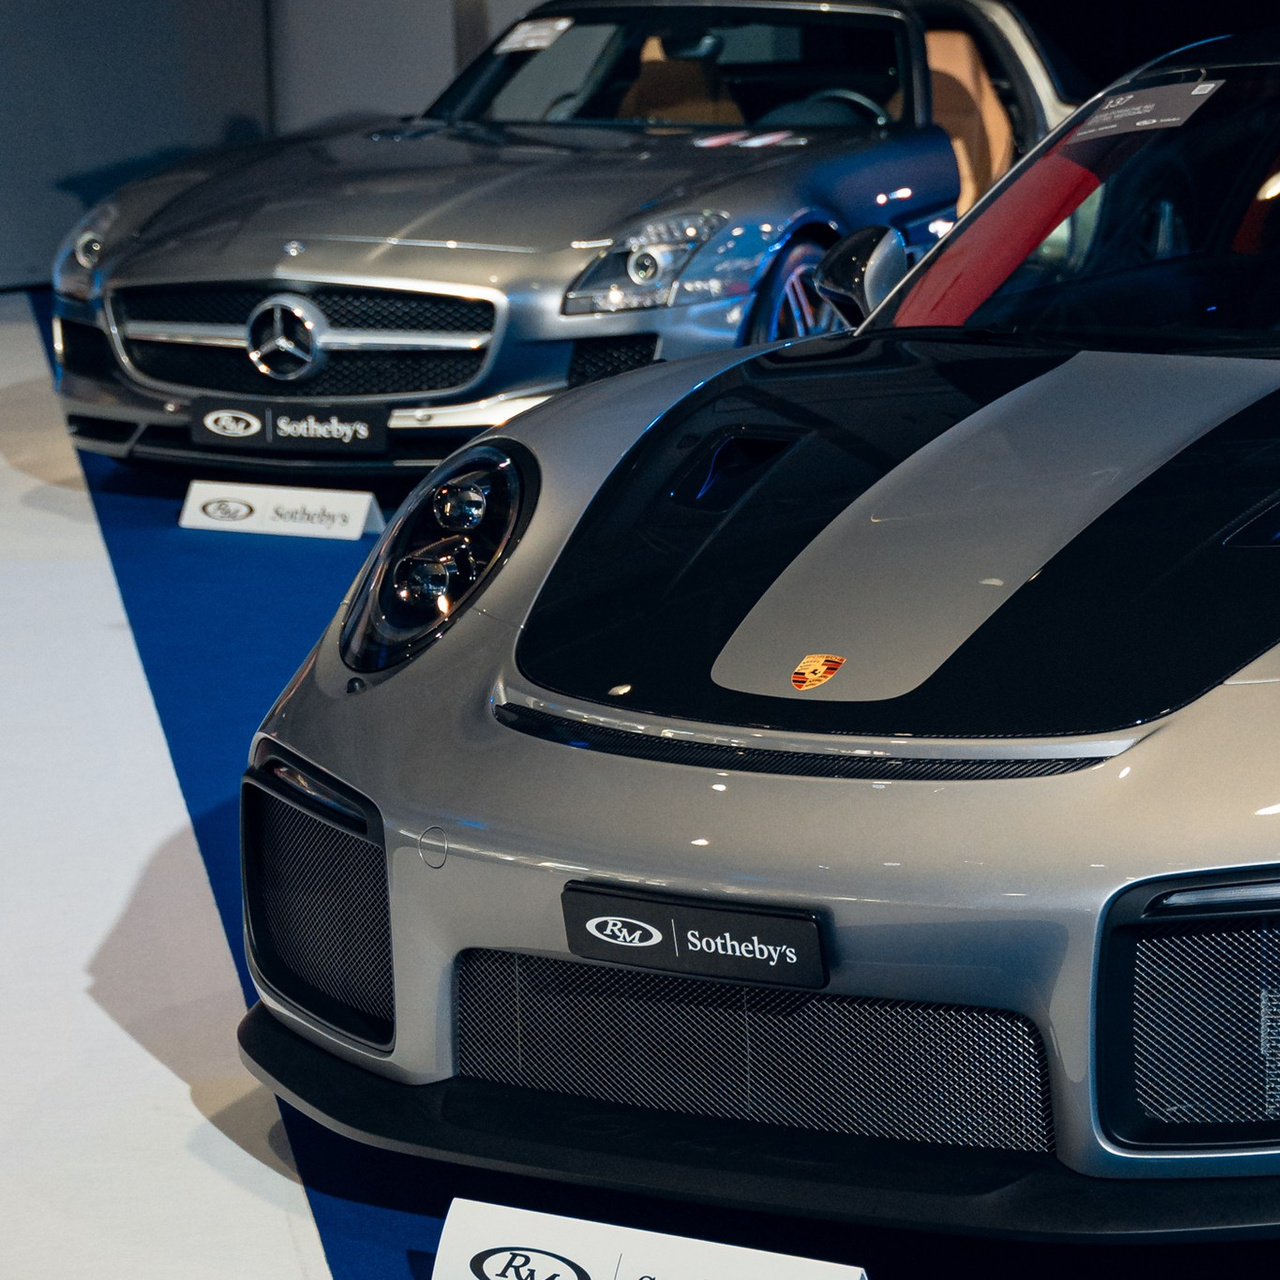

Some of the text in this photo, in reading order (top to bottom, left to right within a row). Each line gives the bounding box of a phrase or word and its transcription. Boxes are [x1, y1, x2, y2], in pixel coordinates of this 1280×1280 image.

[276, 416, 369, 443] Sotheby's
[272, 504, 349, 530] Sotheby's
[687, 930, 797, 966] Sotheby's
